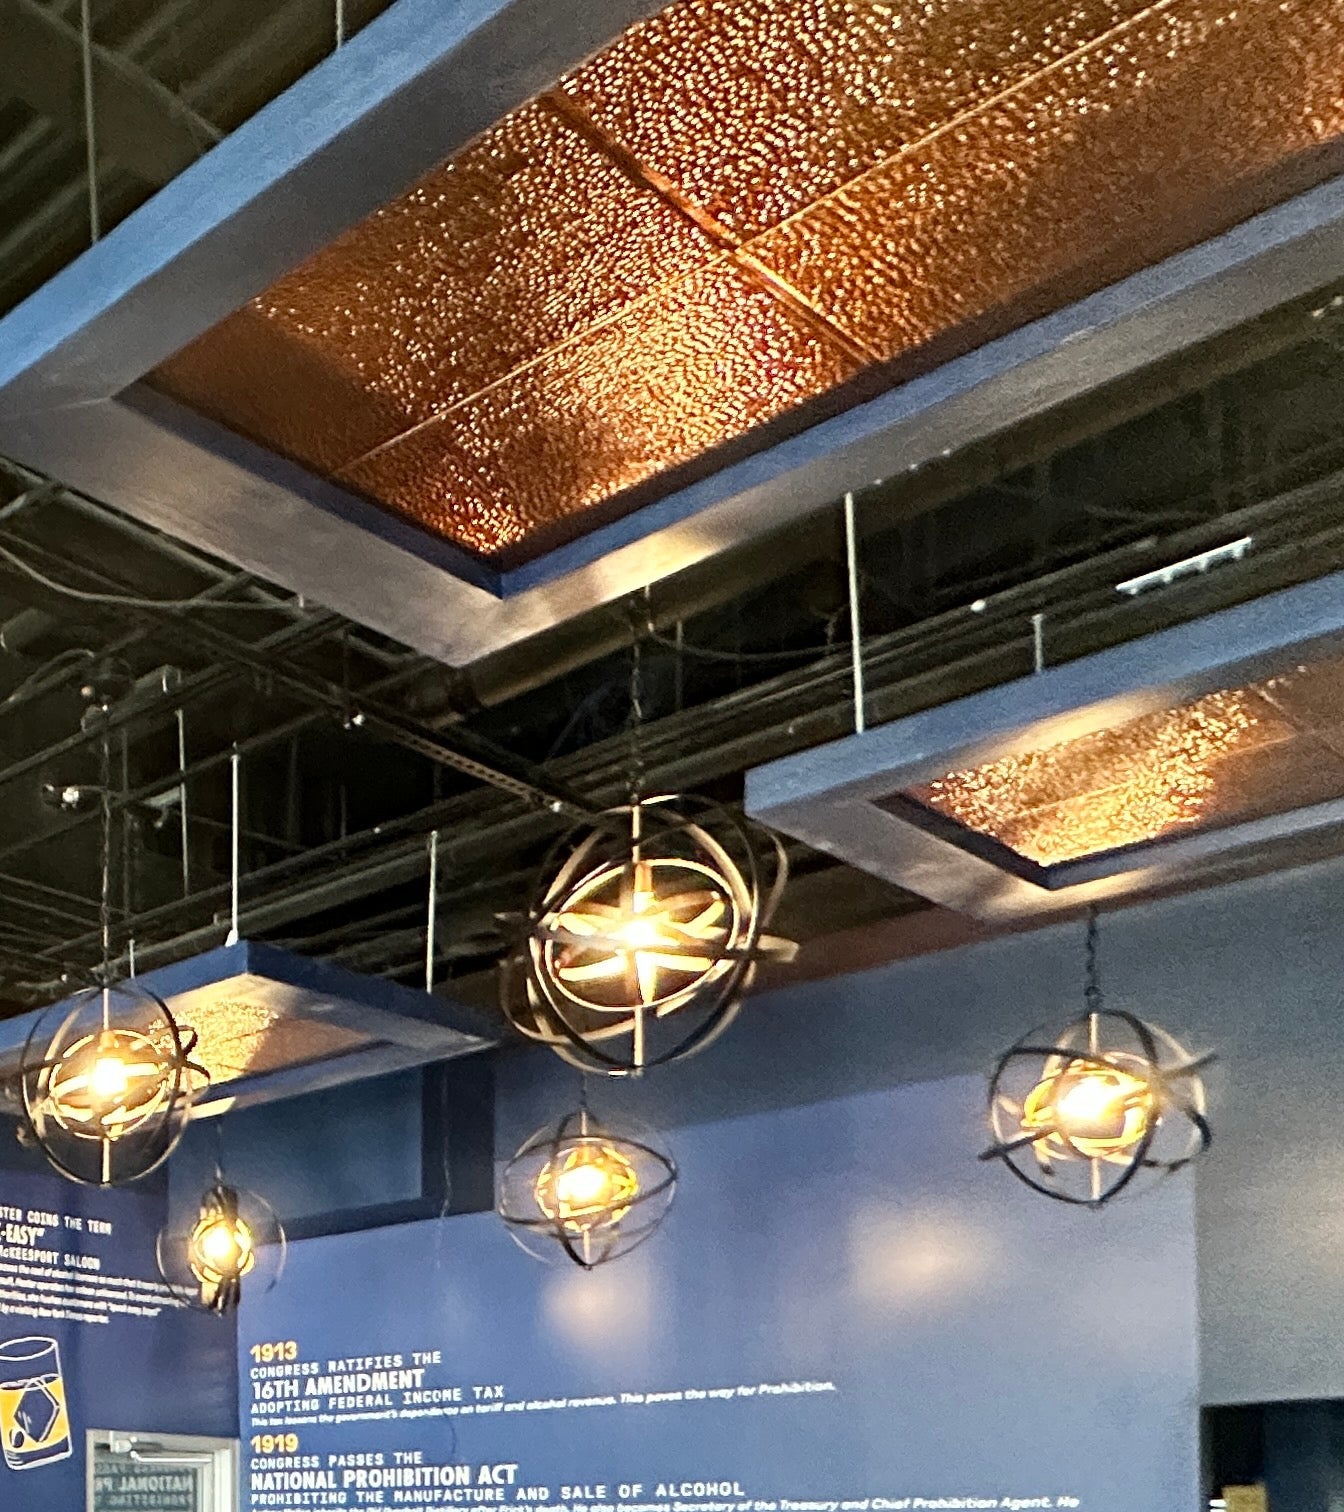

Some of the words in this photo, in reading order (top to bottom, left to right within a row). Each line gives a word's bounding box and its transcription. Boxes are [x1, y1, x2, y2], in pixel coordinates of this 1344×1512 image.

[64, 1215, 82, 1230] THE
[63, 1253, 101, 1270] SALOON
[249, 1341, 297, 1363] 1913
[250, 1362, 319, 1379] CONGRESS
[328, 1354, 403, 1373] RATIFIES
[411, 1350, 441, 1365] THE
[251, 1378, 299, 1400] 16TH
[304, 1368, 425, 1396] AMENDMENT
[250, 1398, 320, 1414] ADOPTING
[328, 1393, 393, 1410] FEDERAL
[402, 1387, 462, 1405] INCOME
[472, 1384, 504, 1399] TAX
[250, 1432, 299, 1454] 1919
[250, 1455, 319, 1470] CONGRESS
[328, 1452, 384, 1468] PASSES
[392, 1451, 422, 1464] THE
[251, 1470, 337, 1490] NATIONAL
[343, 1465, 470, 1488] PROHIBITION
[477, 1463, 518, 1485] ACT
[251, 1491, 347, 1505] PROHIBITING
[355, 1490, 384, 1503] THE
[393, 1487, 505, 1502] MANUFACTURE
[516, 1486, 549, 1500] AND
[561, 1484, 606, 1500] SALE
[618, 1483, 643, 1498] OF
[655, 1481, 745, 1497] ALCOHOL
